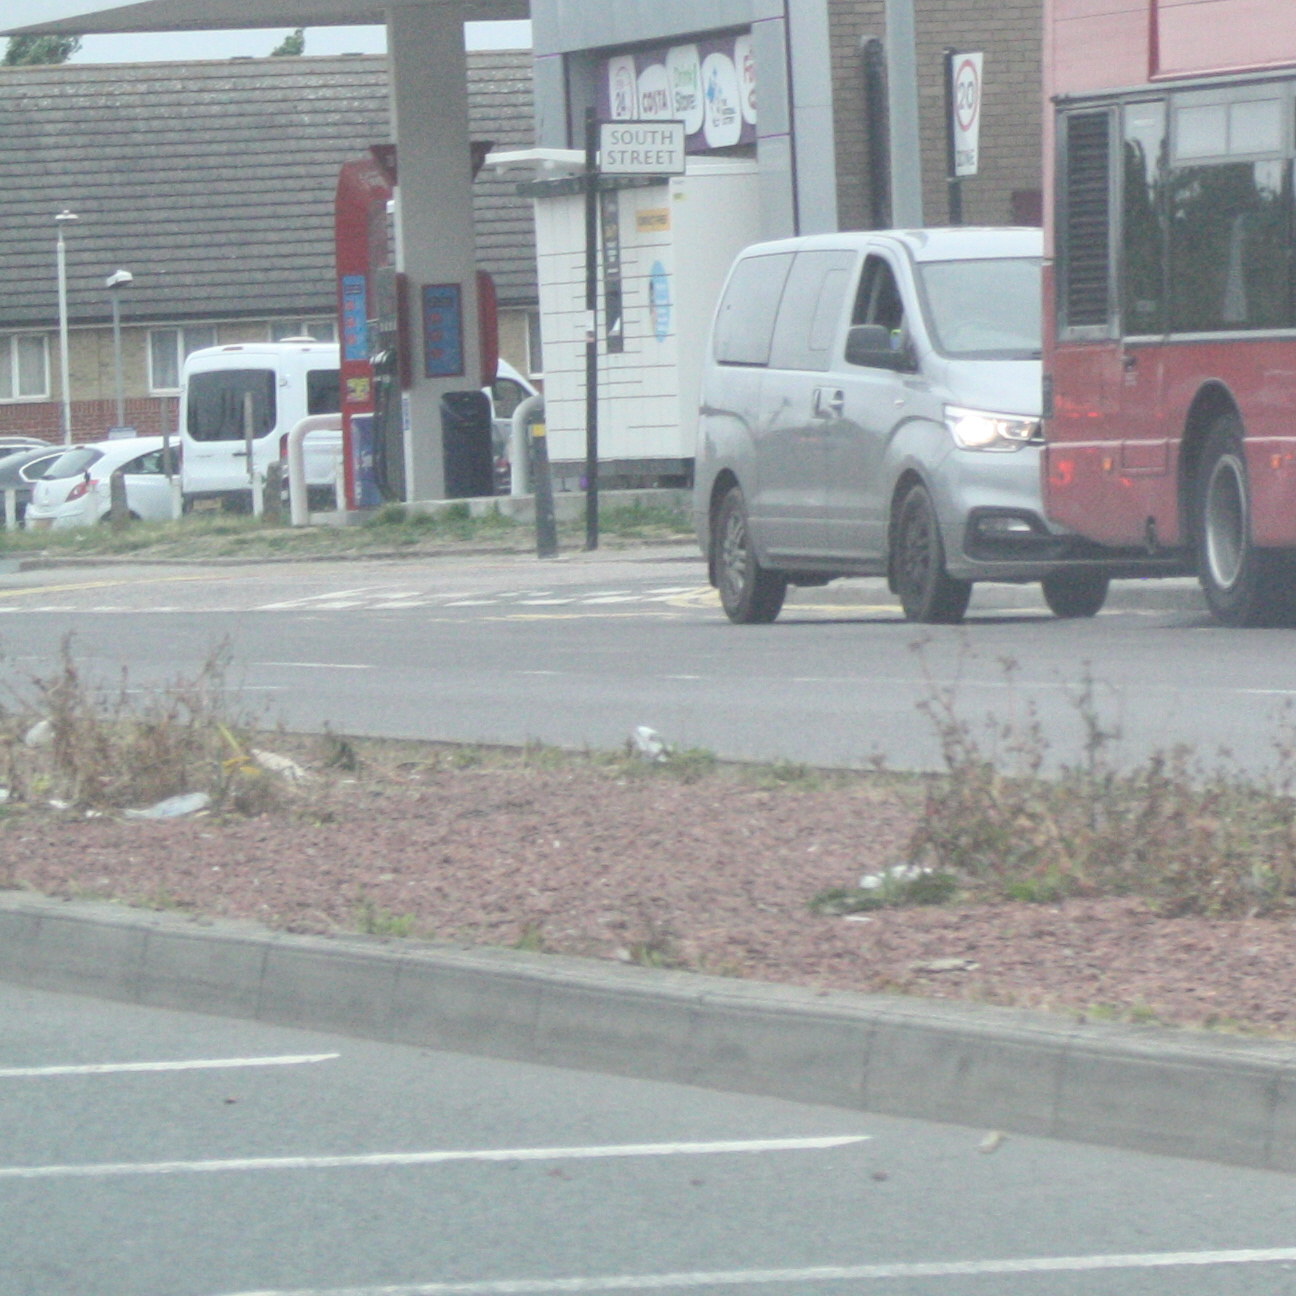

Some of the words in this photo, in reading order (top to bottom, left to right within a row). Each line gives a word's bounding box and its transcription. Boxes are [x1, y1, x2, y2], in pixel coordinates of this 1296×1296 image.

[957, 81, 975, 110] 20
[610, 130, 673, 145] SOUTH
[607, 150, 676, 165] STREET
